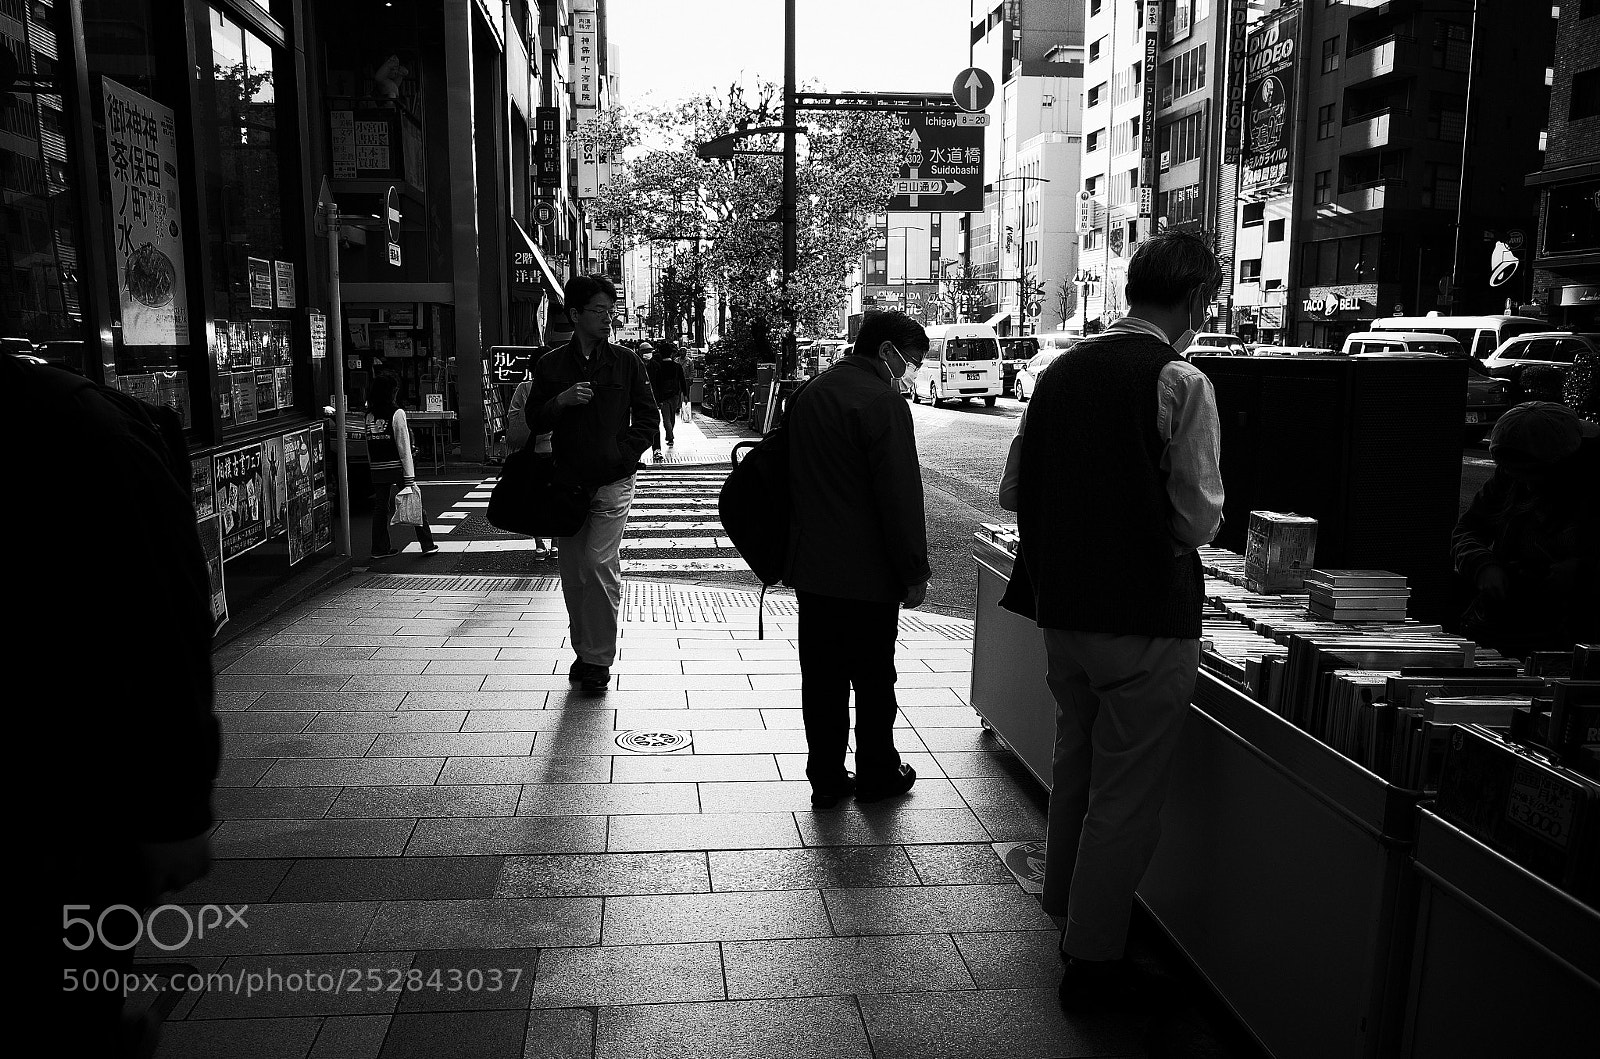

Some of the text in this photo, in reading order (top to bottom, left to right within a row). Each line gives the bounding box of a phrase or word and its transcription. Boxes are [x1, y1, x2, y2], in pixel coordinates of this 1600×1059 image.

[1249, 23, 1280, 55] DVD
[1146, 38, 1156, 72] カラオケ
[1249, 38, 1294, 73] VIDEO
[356, 122, 388, 133] 小宮山
[925, 117, 957, 127] Ichigay
[358, 134, 378, 144] 書店
[543, 120, 554, 172] 田村書店
[142, 107, 161, 189] 神田
[358, 147, 379, 157] 古本
[930, 147, 981, 164] 水道橋
[125, 100, 148, 227] 神保町
[358, 158, 379, 169] 買取
[908, 154, 921, 164] 302
[1243, 147, 1288, 170] ホテルがライバル
[106, 93, 135, 257] 御茶ノ水
[931, 165, 979, 175] Suidobashi
[898, 181, 941, 193] 白山通り
[514, 252, 534, 265] 2階
[515, 269, 542, 284] 洋書
[1302, 298, 1361, 312] TACO BELL
[216, 450, 261, 482] 相撲古書フェア
